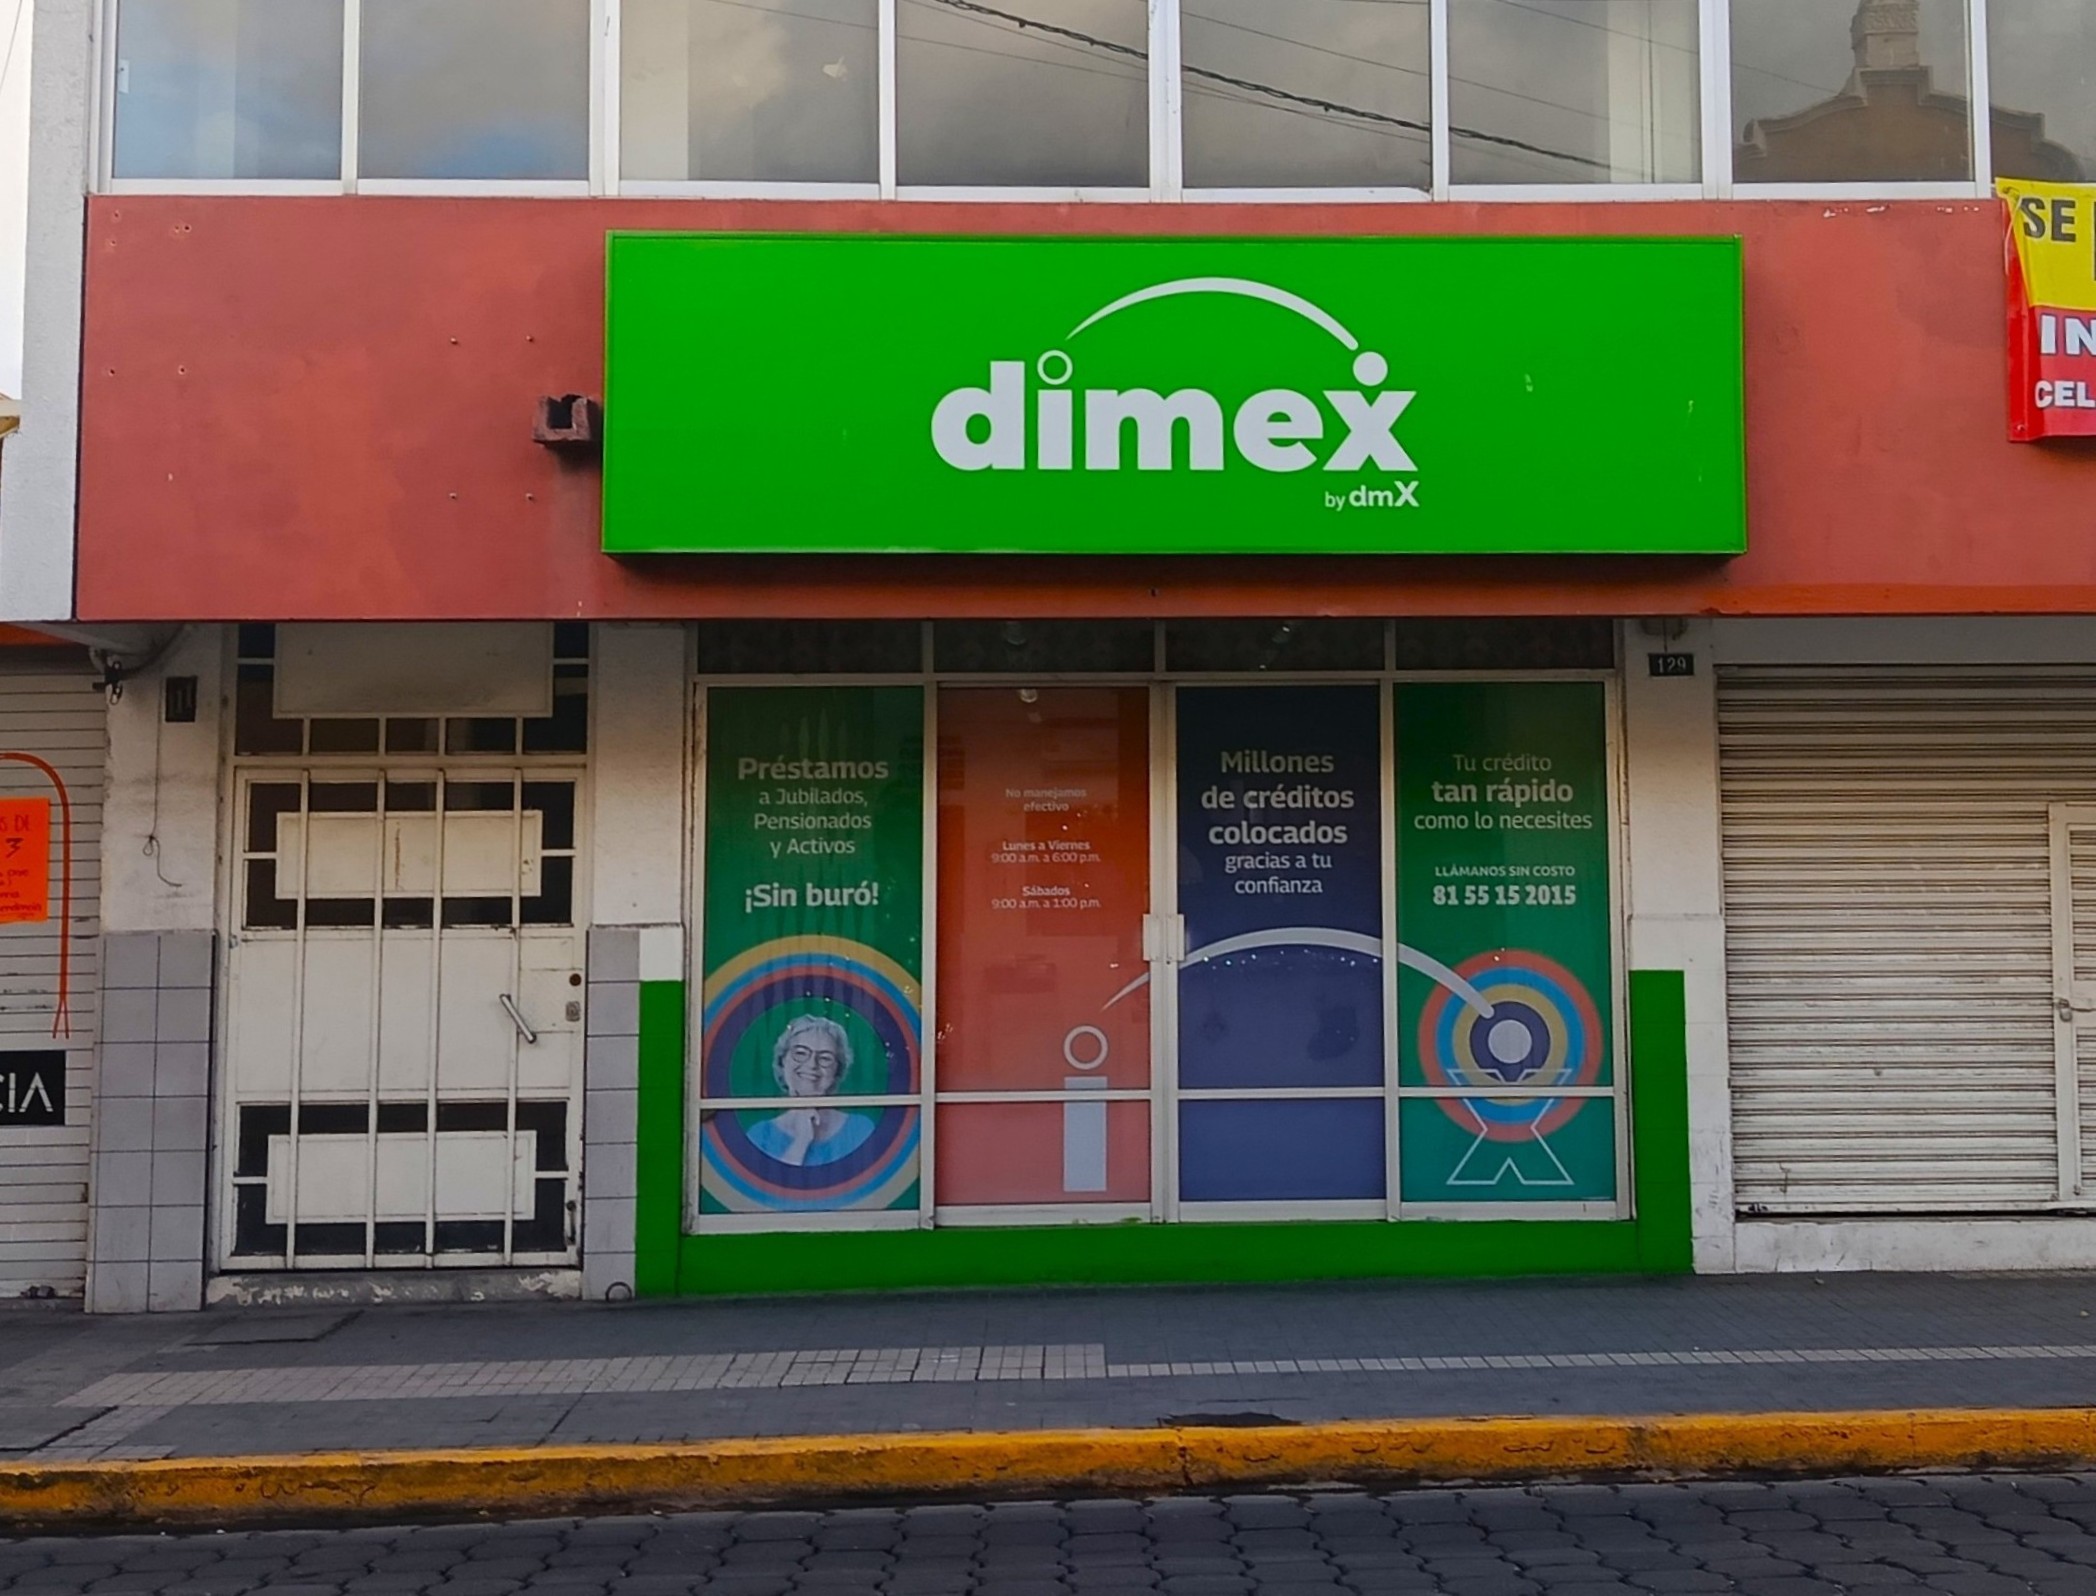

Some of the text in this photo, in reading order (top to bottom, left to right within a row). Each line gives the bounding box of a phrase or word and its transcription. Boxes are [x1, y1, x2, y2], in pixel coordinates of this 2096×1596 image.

[2019, 197, 2076, 242] SE
[2034, 380, 2096, 409] CEL
[931, 350, 1418, 472] dimex
[1325, 480, 1420, 512] by dmX
[1658, 656, 1687, 674] 129
[738, 755, 889, 780] Préstamos
[1221, 750, 1335, 773] Millones
[1453, 752, 1552, 772] Tu crédito
[759, 788, 868, 807] a Jubilados,
[1005, 787, 1087, 799] No manejamos
[1201, 784, 1355, 809] de créditos
[1431, 777, 1574, 808] tan rápido
[1023, 801, 1070, 812] efectivo
[754, 812, 872, 830] Pensionados
[1414, 810, 1593, 829] como lo necesites
[1208, 820, 1348, 844] colocados
[770, 837, 856, 859] y Activos
[1002, 840, 1091, 851] Lunes a Viernes
[991, 853, 1017, 863] 9:00
[1043, 854, 1050, 862] a
[1052, 852, 1078, 863] 6:00
[1224, 852, 1332, 874] gracias a tu
[1435, 863, 1576, 877] LLÁMANOS SIN COSTO
[1022, 885, 1071, 897] Sábados
[1234, 876, 1323, 894] confianza
[1433, 885, 1577, 905] 81 55 15 2015
[745, 880, 879, 913] ¡Sin buró!
[991, 899, 1017, 909] 9:00
[1043, 900, 1050, 909] a
[1053, 898, 1078, 908] 1:00
